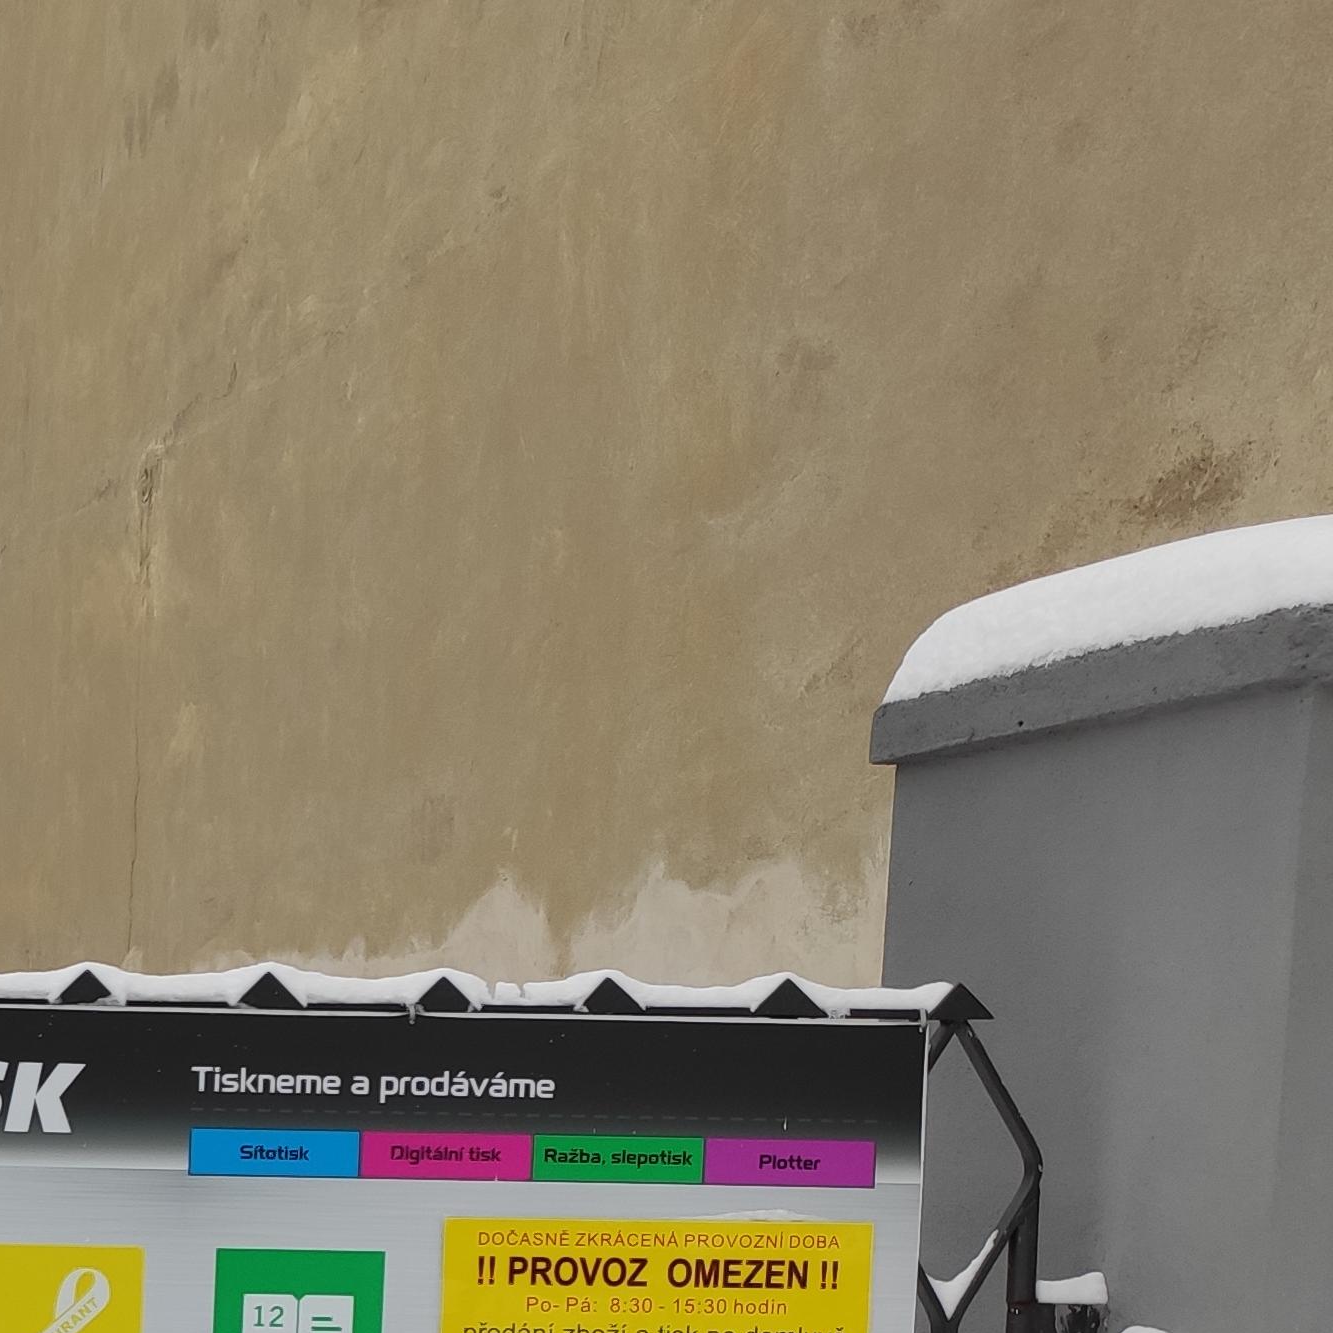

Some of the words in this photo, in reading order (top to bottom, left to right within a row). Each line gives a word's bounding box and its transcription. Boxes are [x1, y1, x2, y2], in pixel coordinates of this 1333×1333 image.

[191, 1066, 340, 1095] Tiskneme
[350, 1076, 370, 1096] a
[381, 1071, 555, 1103] prodáváme
[240, 1145, 309, 1162] Sítotisk
[391, 1145, 463, 1166] Digitální
[469, 1148, 501, 1162] tisk
[544, 1148, 606, 1166] Ražba,
[611, 1150, 692, 1168] slepotisk
[759, 1154, 821, 1171] Plotter
[478, 1229, 570, 1247] DOČASNĚ
[575, 1230, 678, 1247] ZKRÁCENÁ
[684, 1232, 785, 1249] PROVOZNÍ
[788, 1234, 840, 1250] DOBA
[508, 1257, 649, 1287] PROVOZ
[667, 1258, 808, 1289] OMEZEN
[252, 1304, 285, 1329] 12
[566, 1297, 598, 1313] Pá:
[609, 1298, 653, 1314] 8:30
[673, 1299, 728, 1315] 15:30
[733, 1300, 787, 1316] hodin
